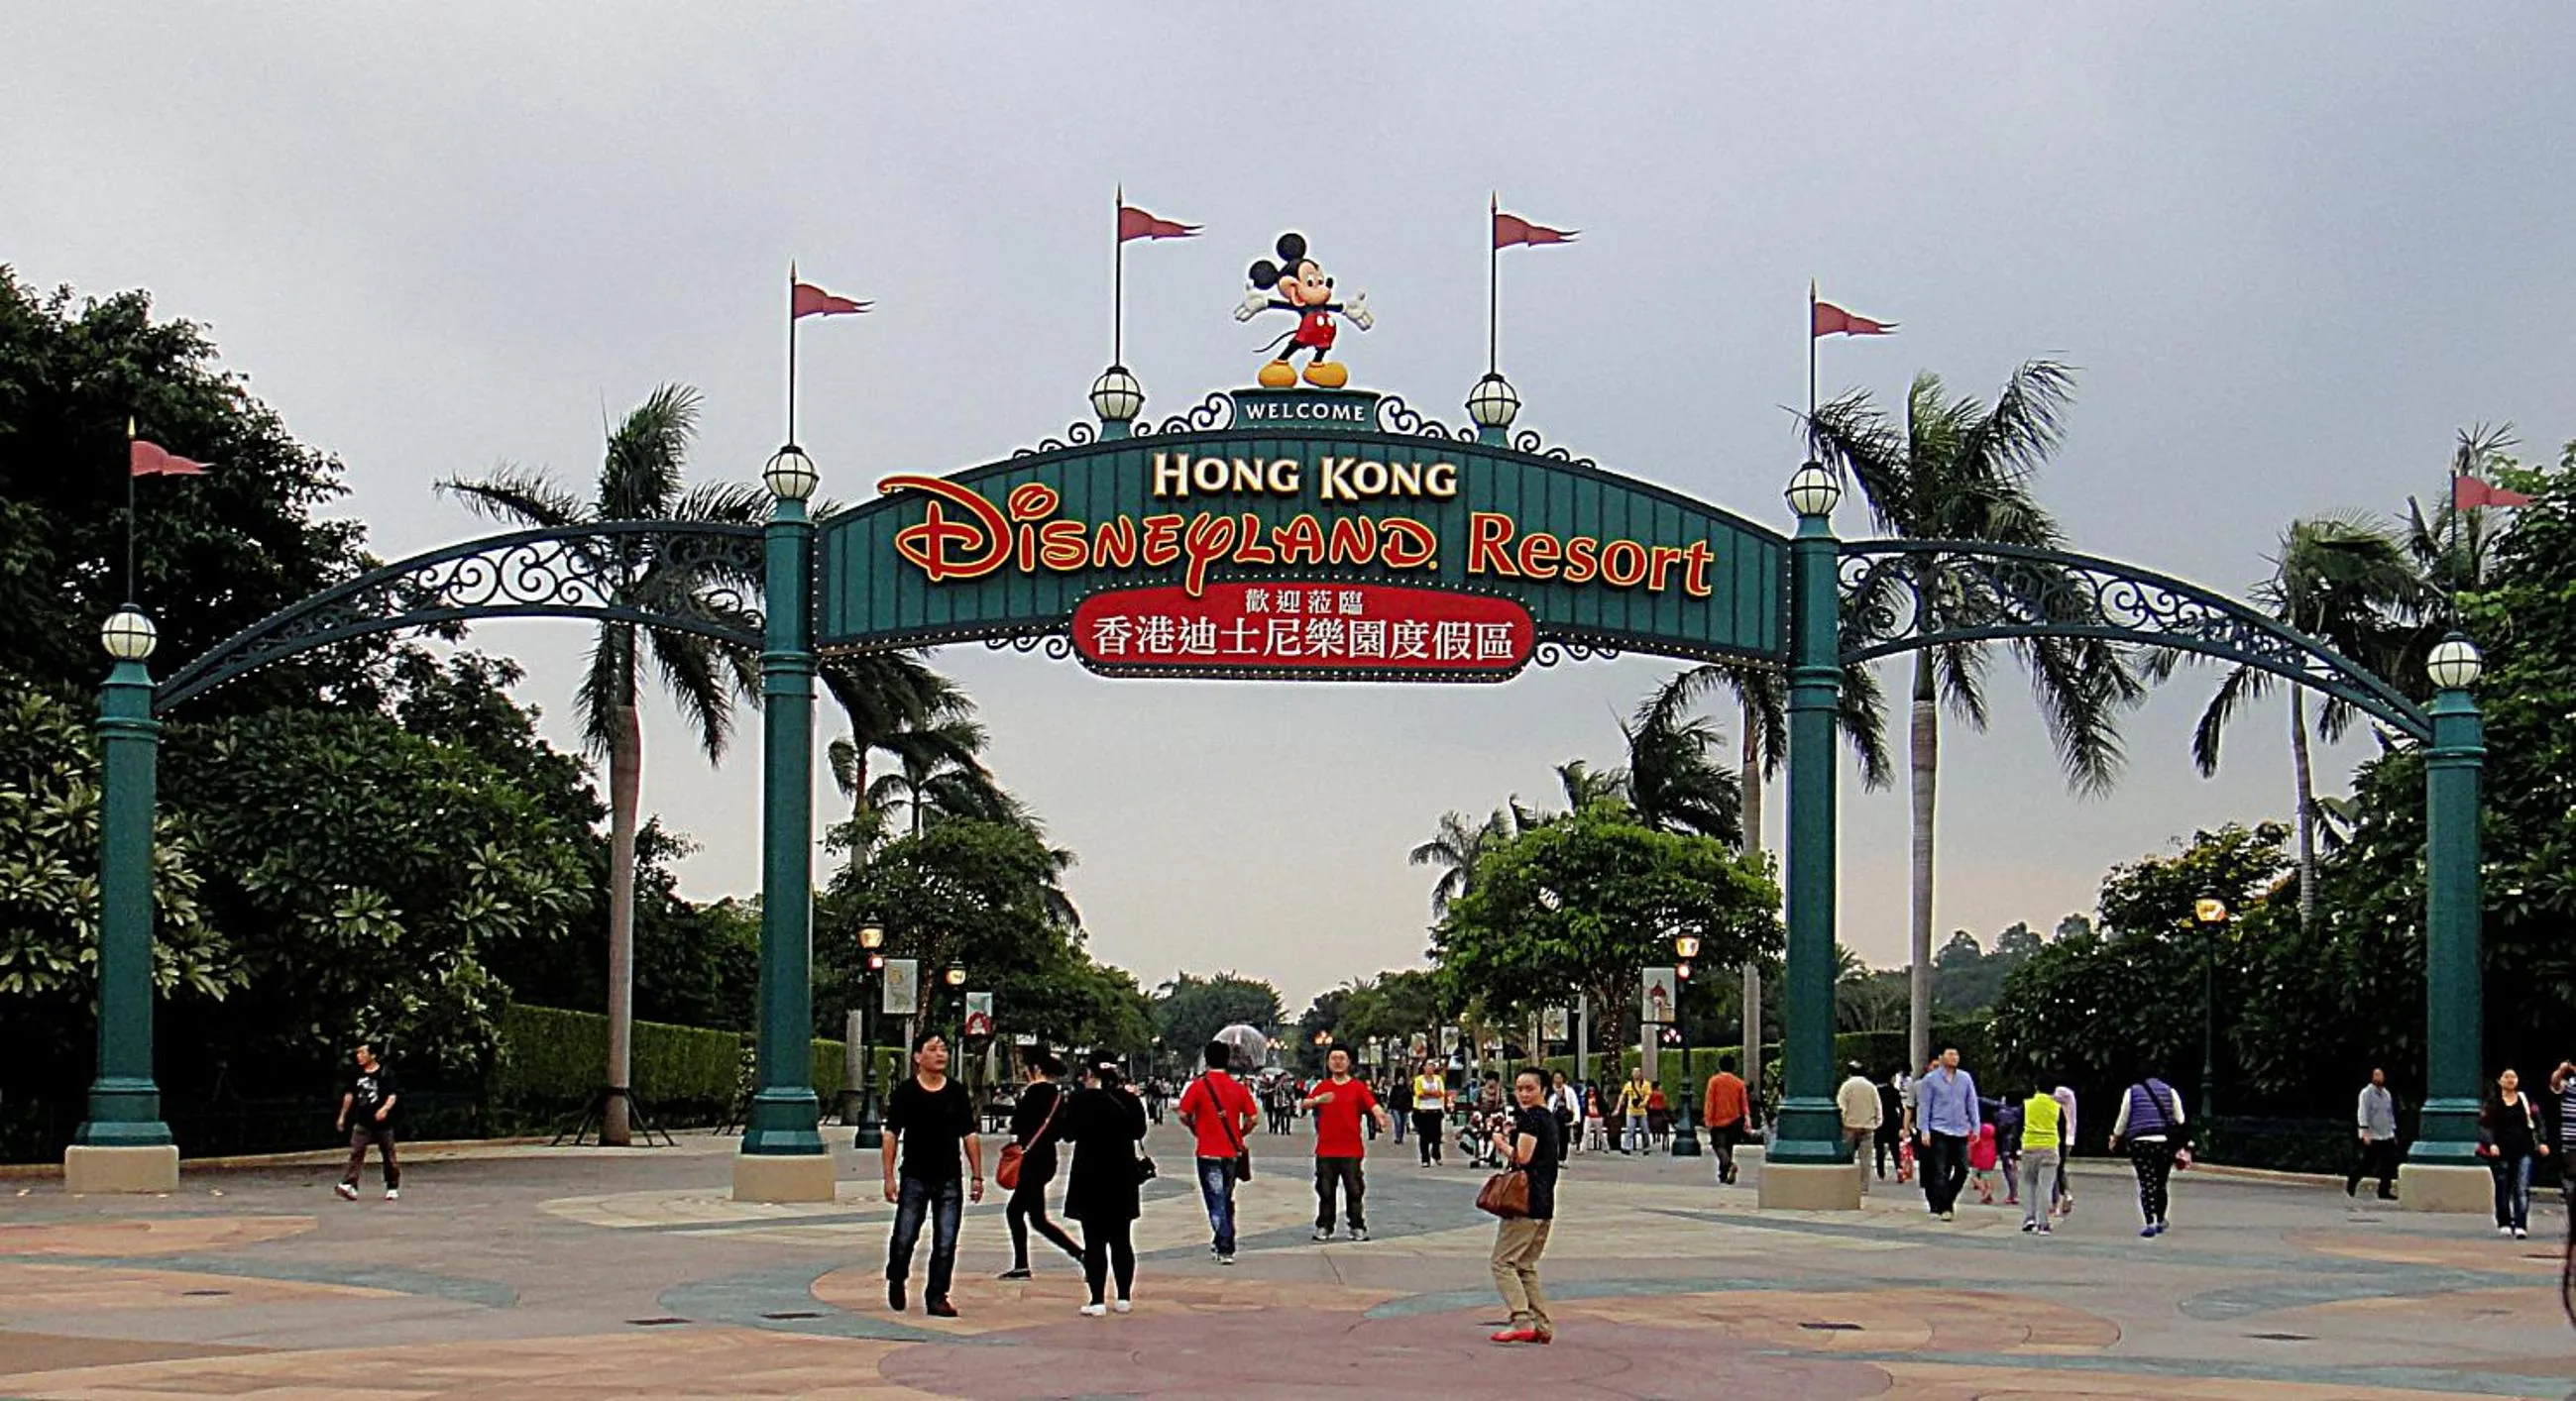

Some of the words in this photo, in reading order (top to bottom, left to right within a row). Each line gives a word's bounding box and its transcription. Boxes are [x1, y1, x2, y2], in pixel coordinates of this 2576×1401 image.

[1246, 403, 1365, 421] WELCOME
[1153, 452, 1299, 496] HONG
[1320, 456, 1457, 500] KONG
[1468, 512, 1714, 595] Resort
[1245, 589, 1363, 614] 歡迎蒞臨
[1092, 616, 1514, 660] 香港迪士尼樂園度假區
